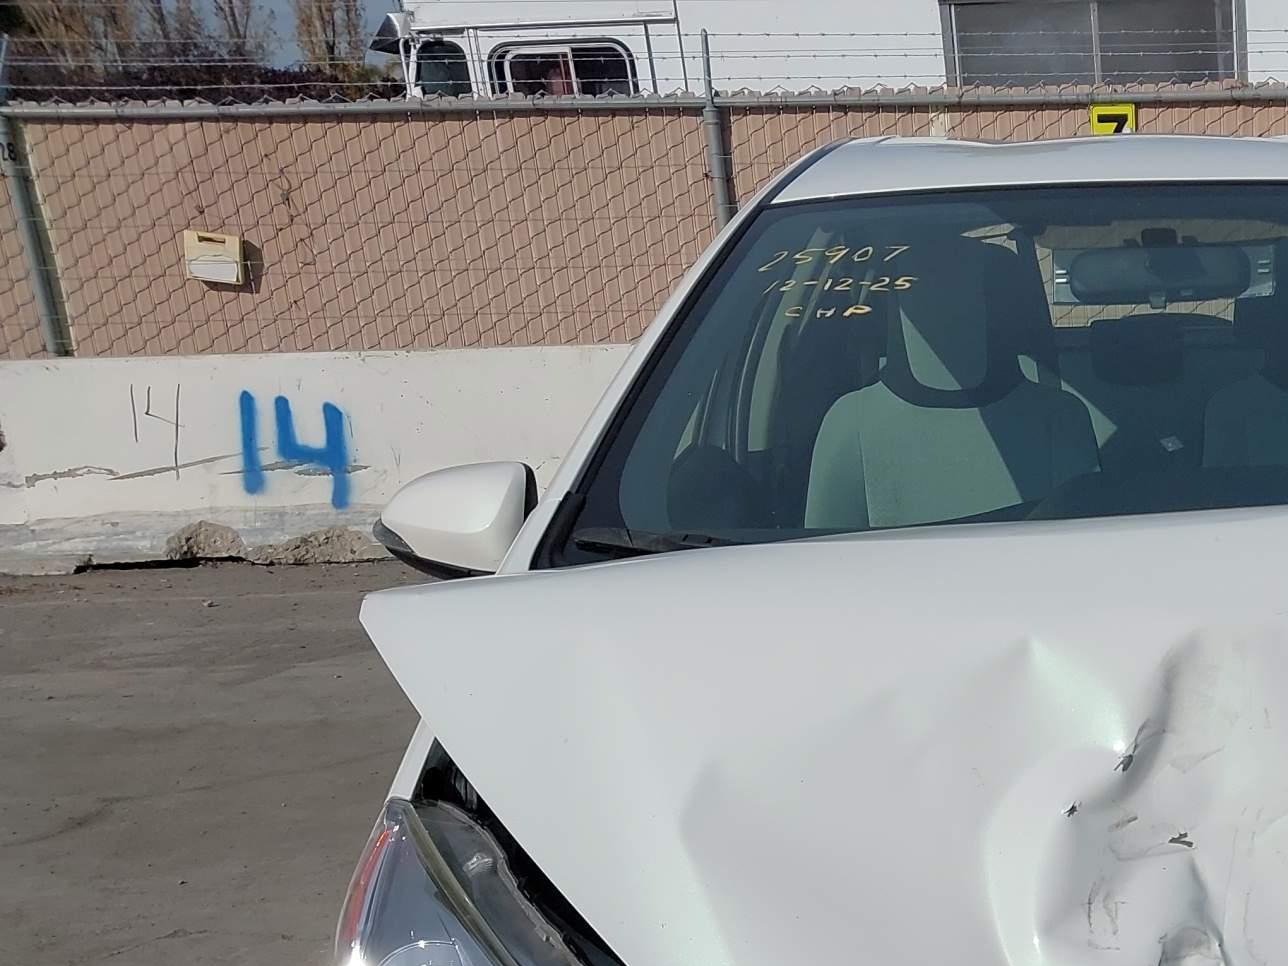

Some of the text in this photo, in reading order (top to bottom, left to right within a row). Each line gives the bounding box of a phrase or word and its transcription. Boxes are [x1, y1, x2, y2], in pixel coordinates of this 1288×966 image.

[1097, 113, 1128, 134] 7
[758, 245, 911, 272] 25907
[762, 276, 919, 295] 12-12-25
[239, 390, 350, 510] 14
